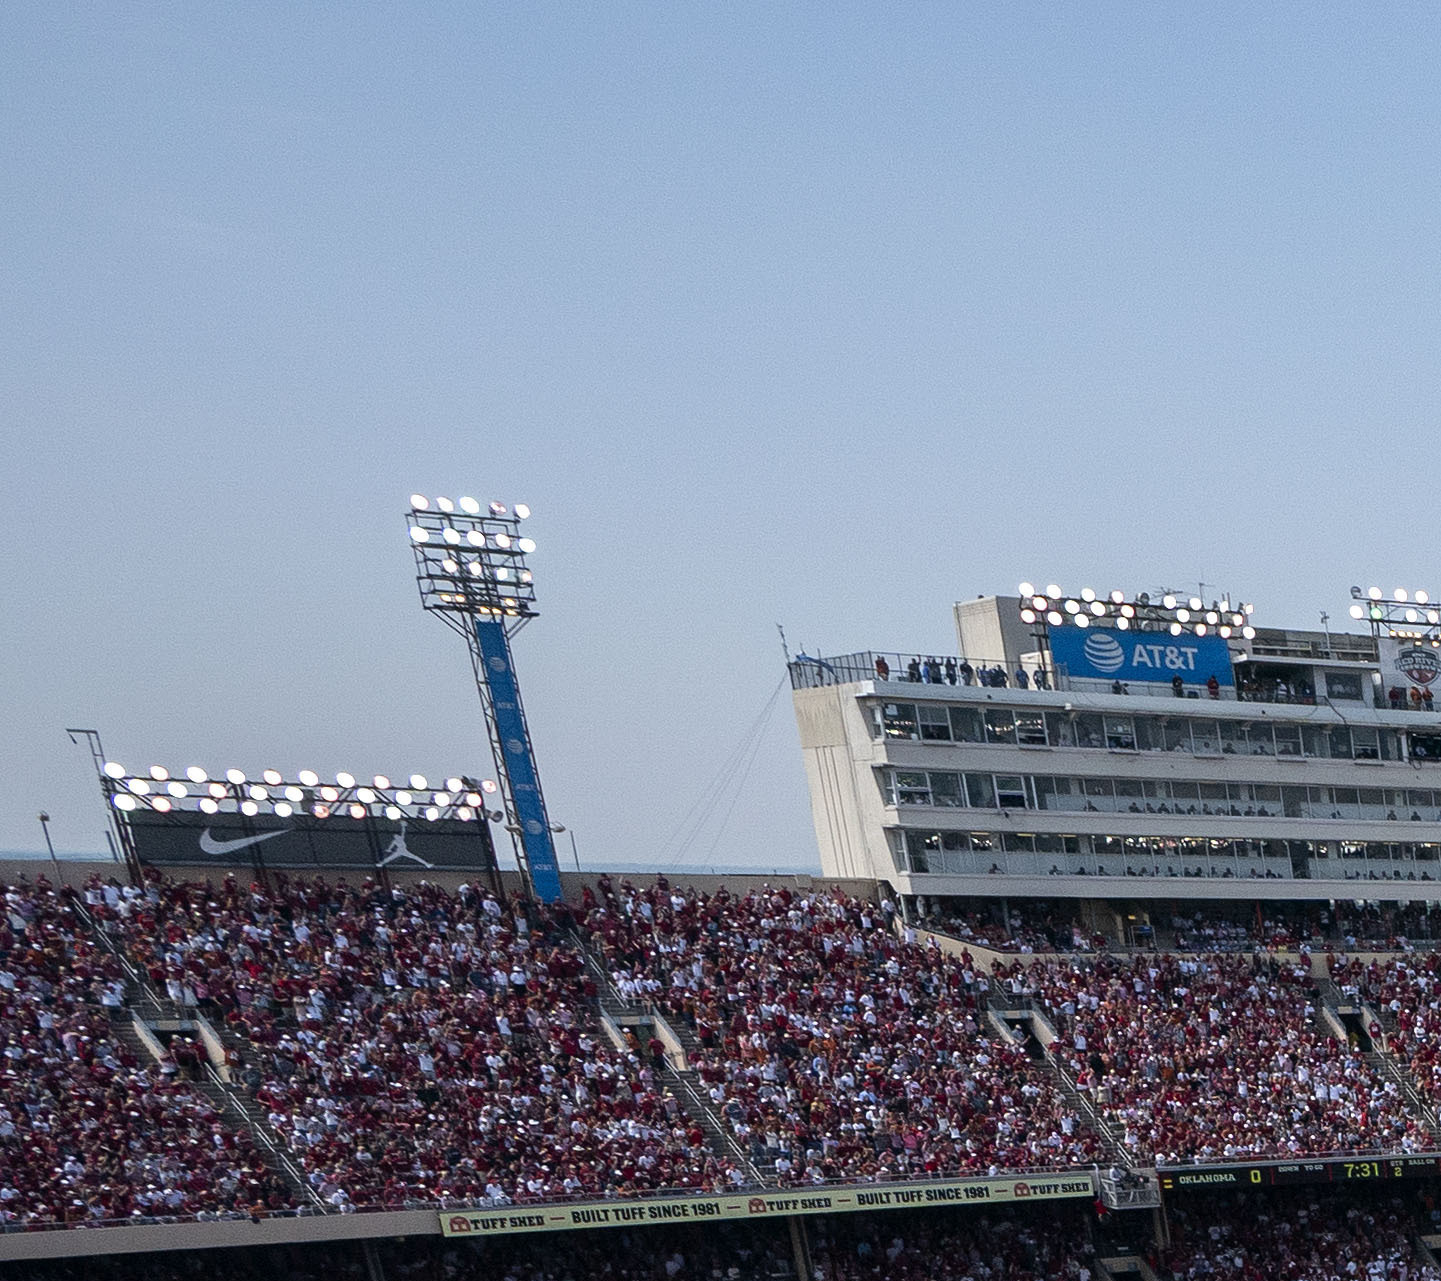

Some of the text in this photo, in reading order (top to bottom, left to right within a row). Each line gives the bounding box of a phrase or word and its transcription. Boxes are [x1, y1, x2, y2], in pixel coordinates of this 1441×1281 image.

[1132, 644, 1198, 670] AT&T
[1179, 1169, 1261, 1184] OKLAHOMA 0
[1344, 1162, 1379, 1178] 7:31
[766, 1181, 1089, 1211] TUFF SHED BUILT TUFF SINCE 1981 TUFF SHED
[471, 1202, 720, 1230] TUFF SHED BUILT TUFF SINCE 1981
